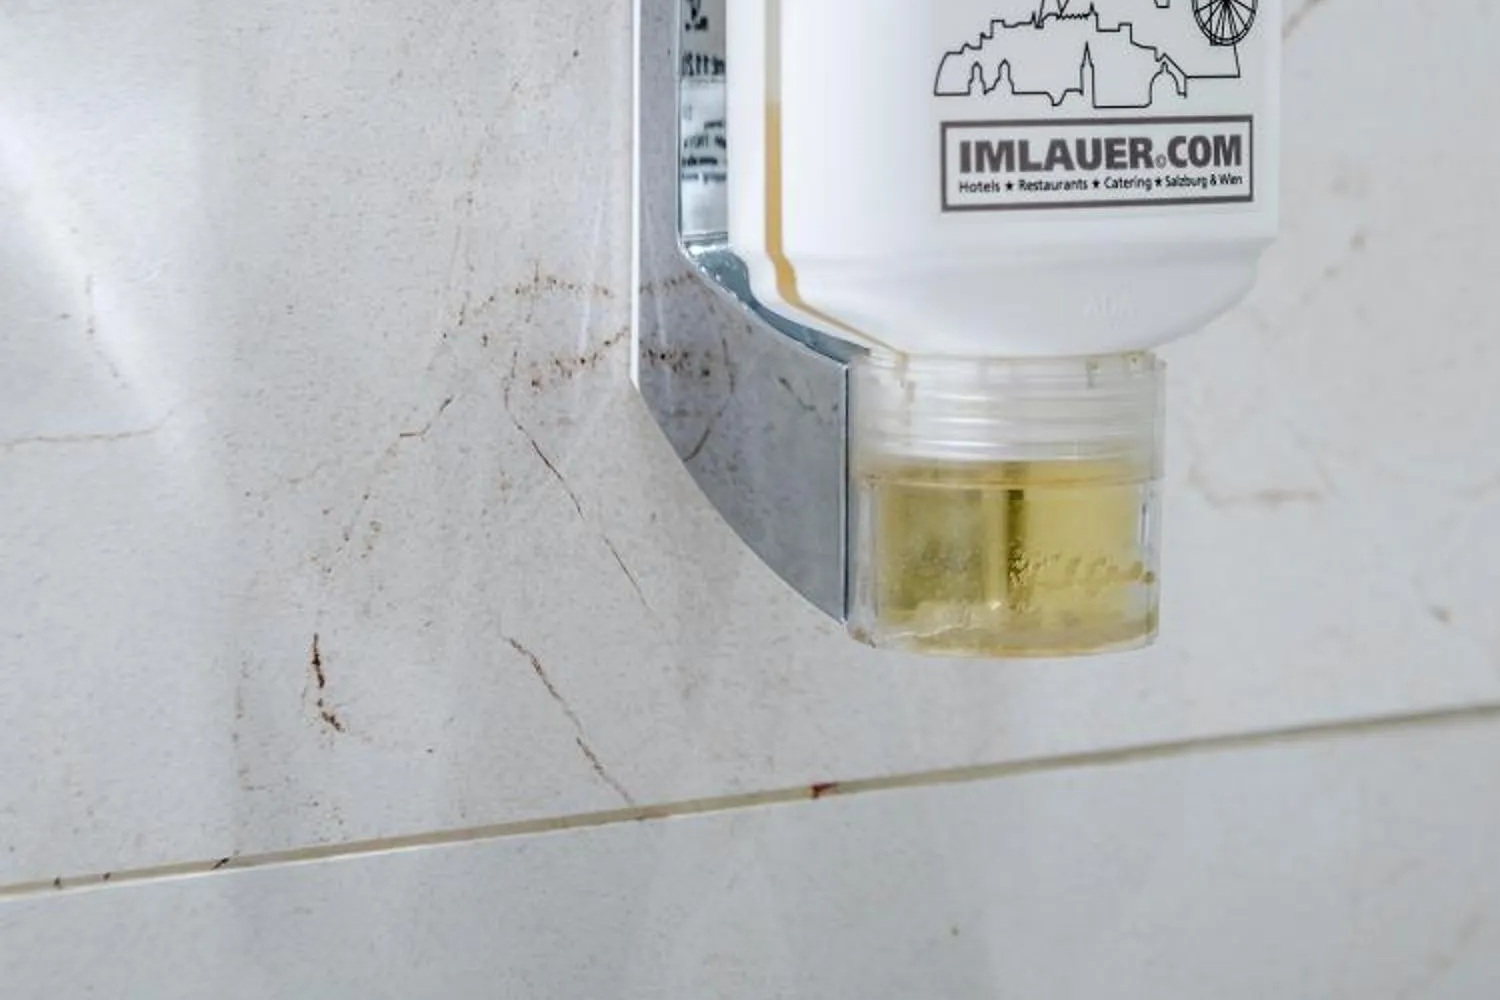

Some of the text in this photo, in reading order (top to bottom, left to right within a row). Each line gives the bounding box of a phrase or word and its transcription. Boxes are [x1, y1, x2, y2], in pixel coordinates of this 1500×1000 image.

[959, 173, 1243, 193] Hotels Restaurants Catering Salzburg & Wien
